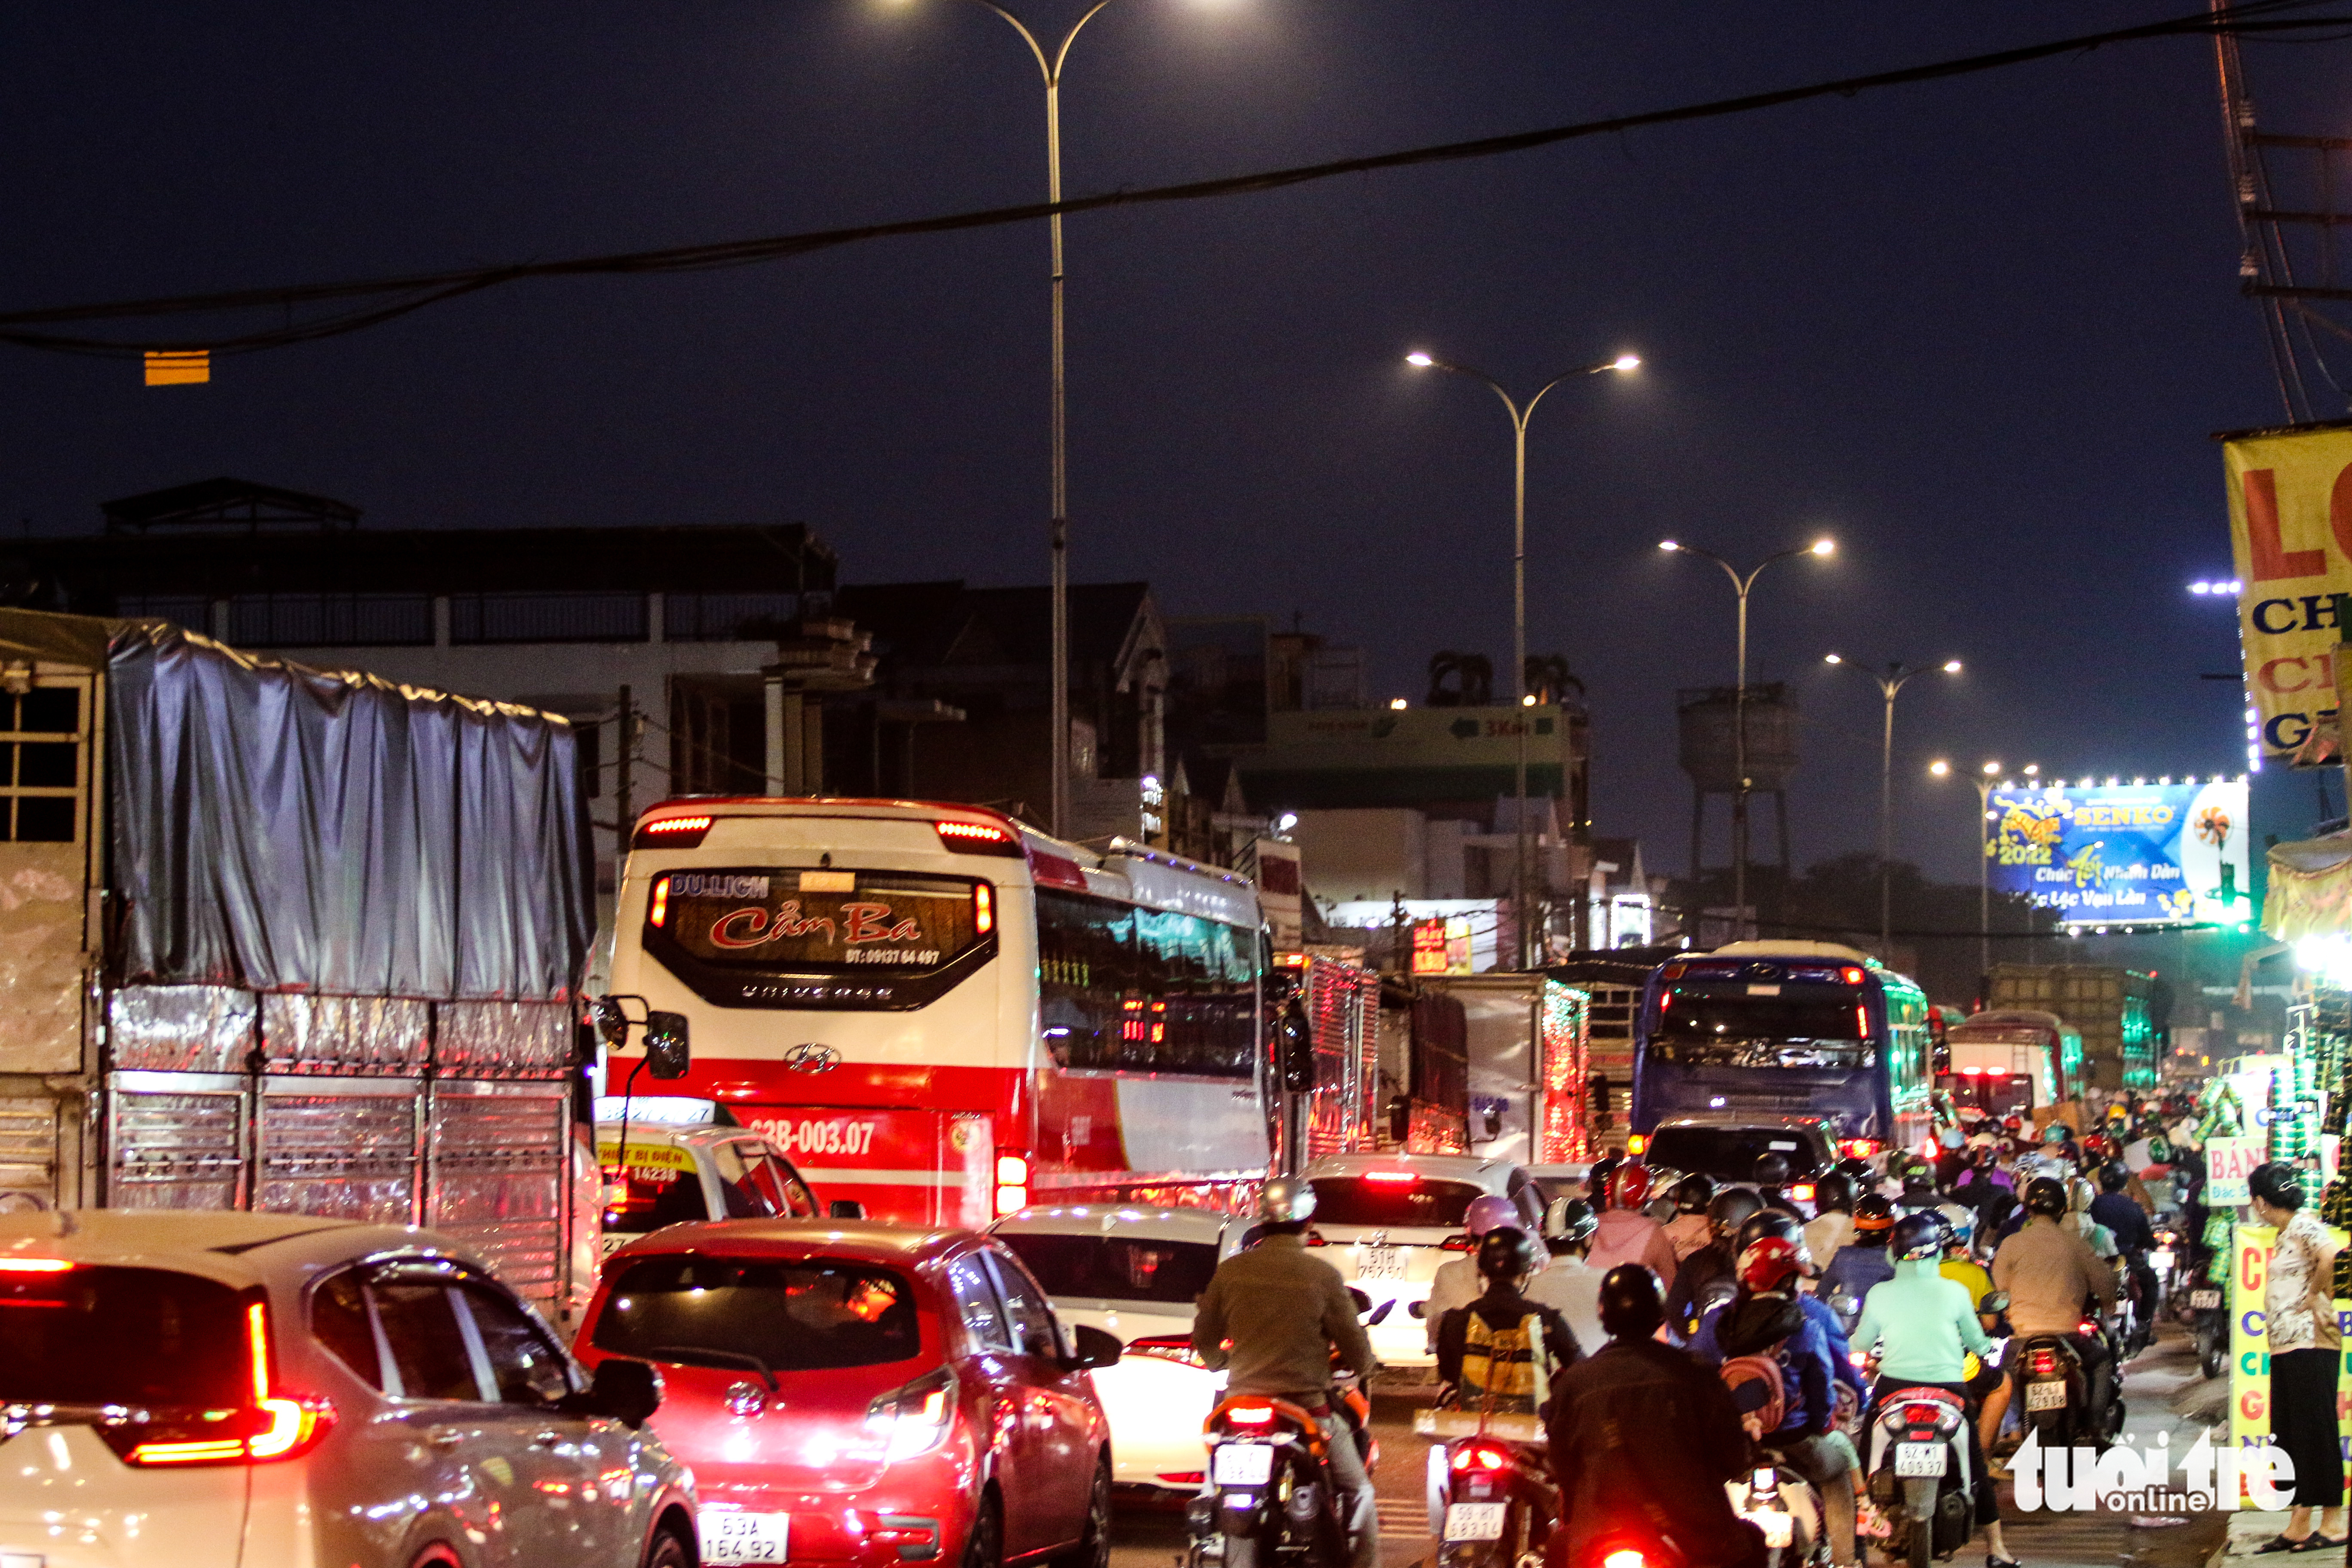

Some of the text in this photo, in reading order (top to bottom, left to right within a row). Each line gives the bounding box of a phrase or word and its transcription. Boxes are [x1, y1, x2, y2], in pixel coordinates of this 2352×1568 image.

[2074, 806, 2174, 825] SENKO
[840, 902, 921, 944] Ba
[723, 1517, 760, 1536] 63A
